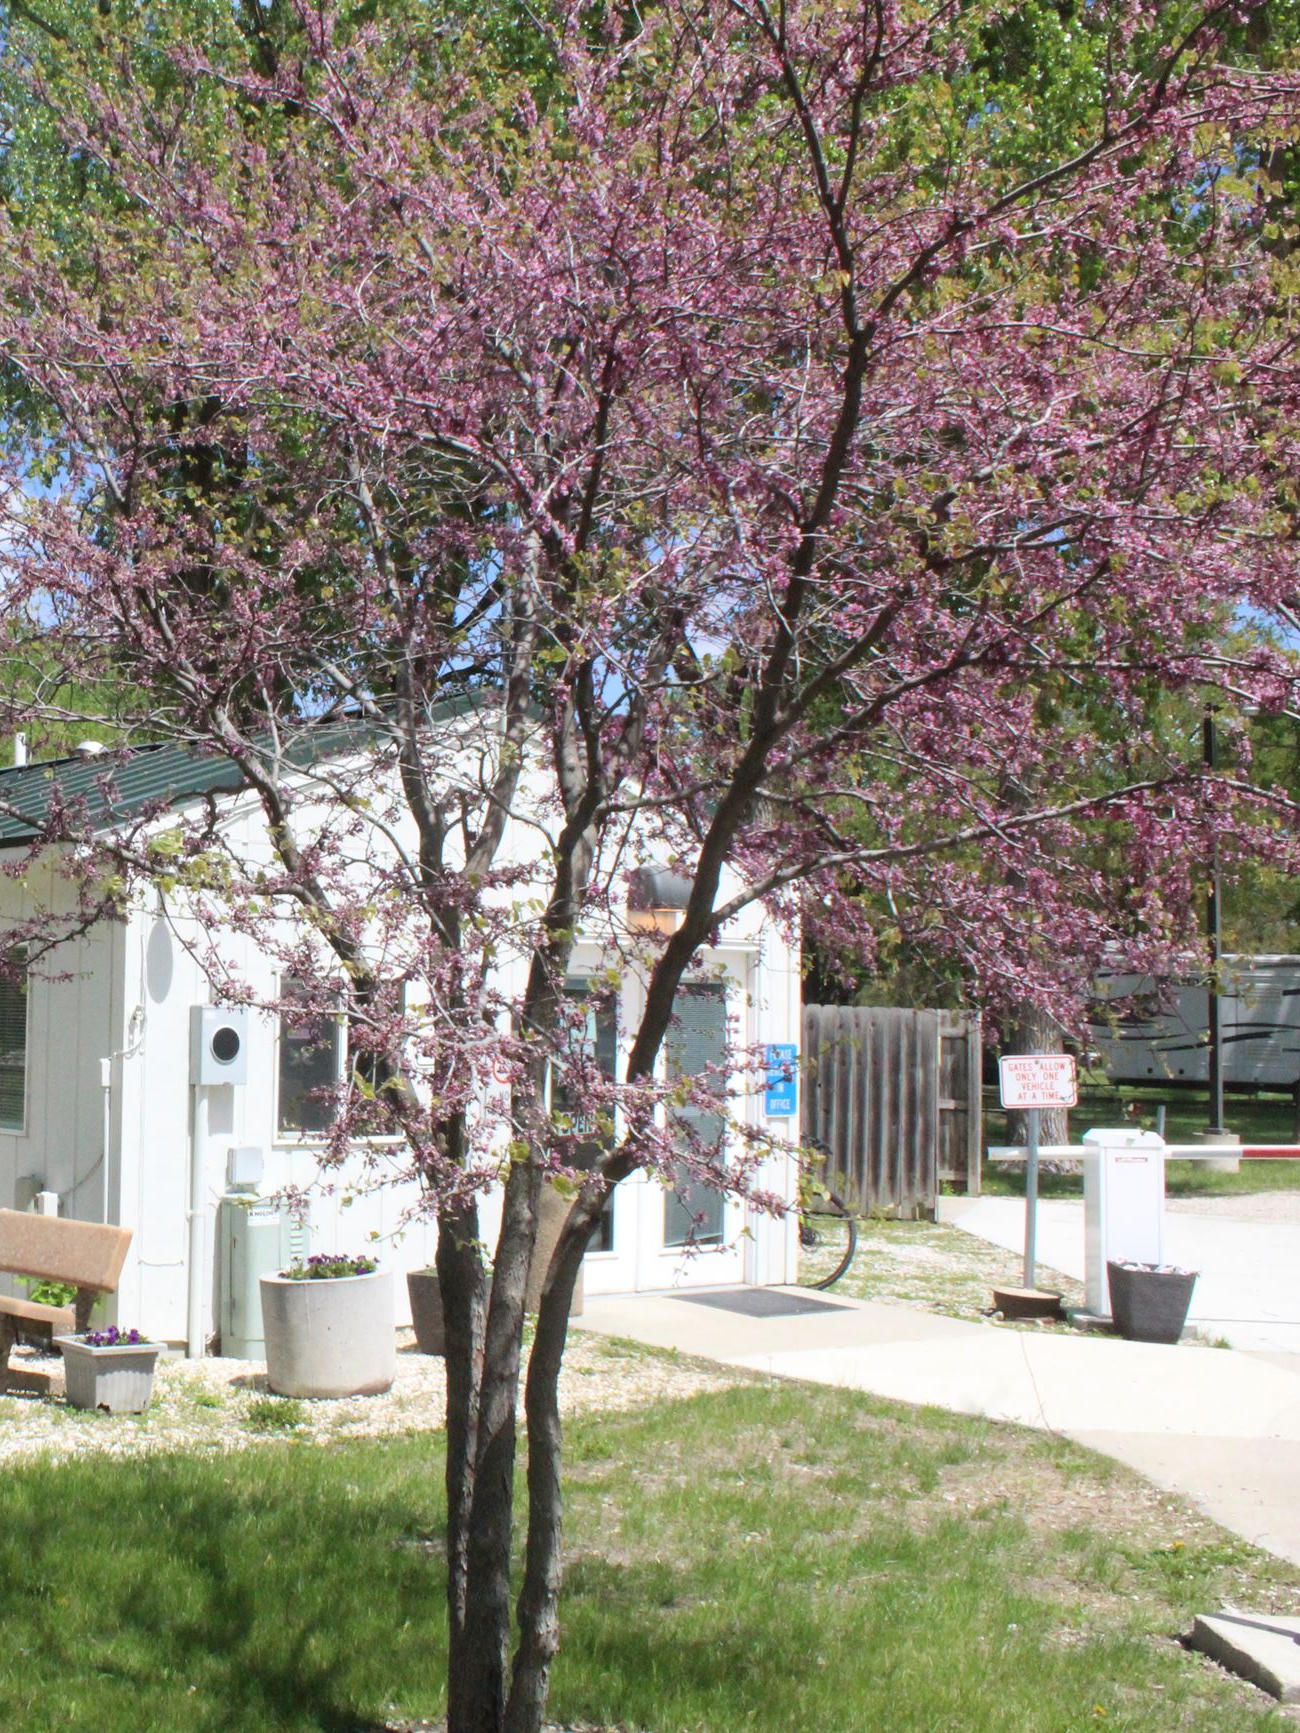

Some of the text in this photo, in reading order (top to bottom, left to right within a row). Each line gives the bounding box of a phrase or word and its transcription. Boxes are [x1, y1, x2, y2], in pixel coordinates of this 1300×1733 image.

[1008, 1062, 1066, 1072] GATES ALLOW
[1015, 1072, 1060, 1081] ONLY ONE
[1021, 1081, 1055, 1090] VEHICLE
[1017, 1091, 1060, 1100] AT A TIME
[769, 1098, 792, 1110] OFFICE
